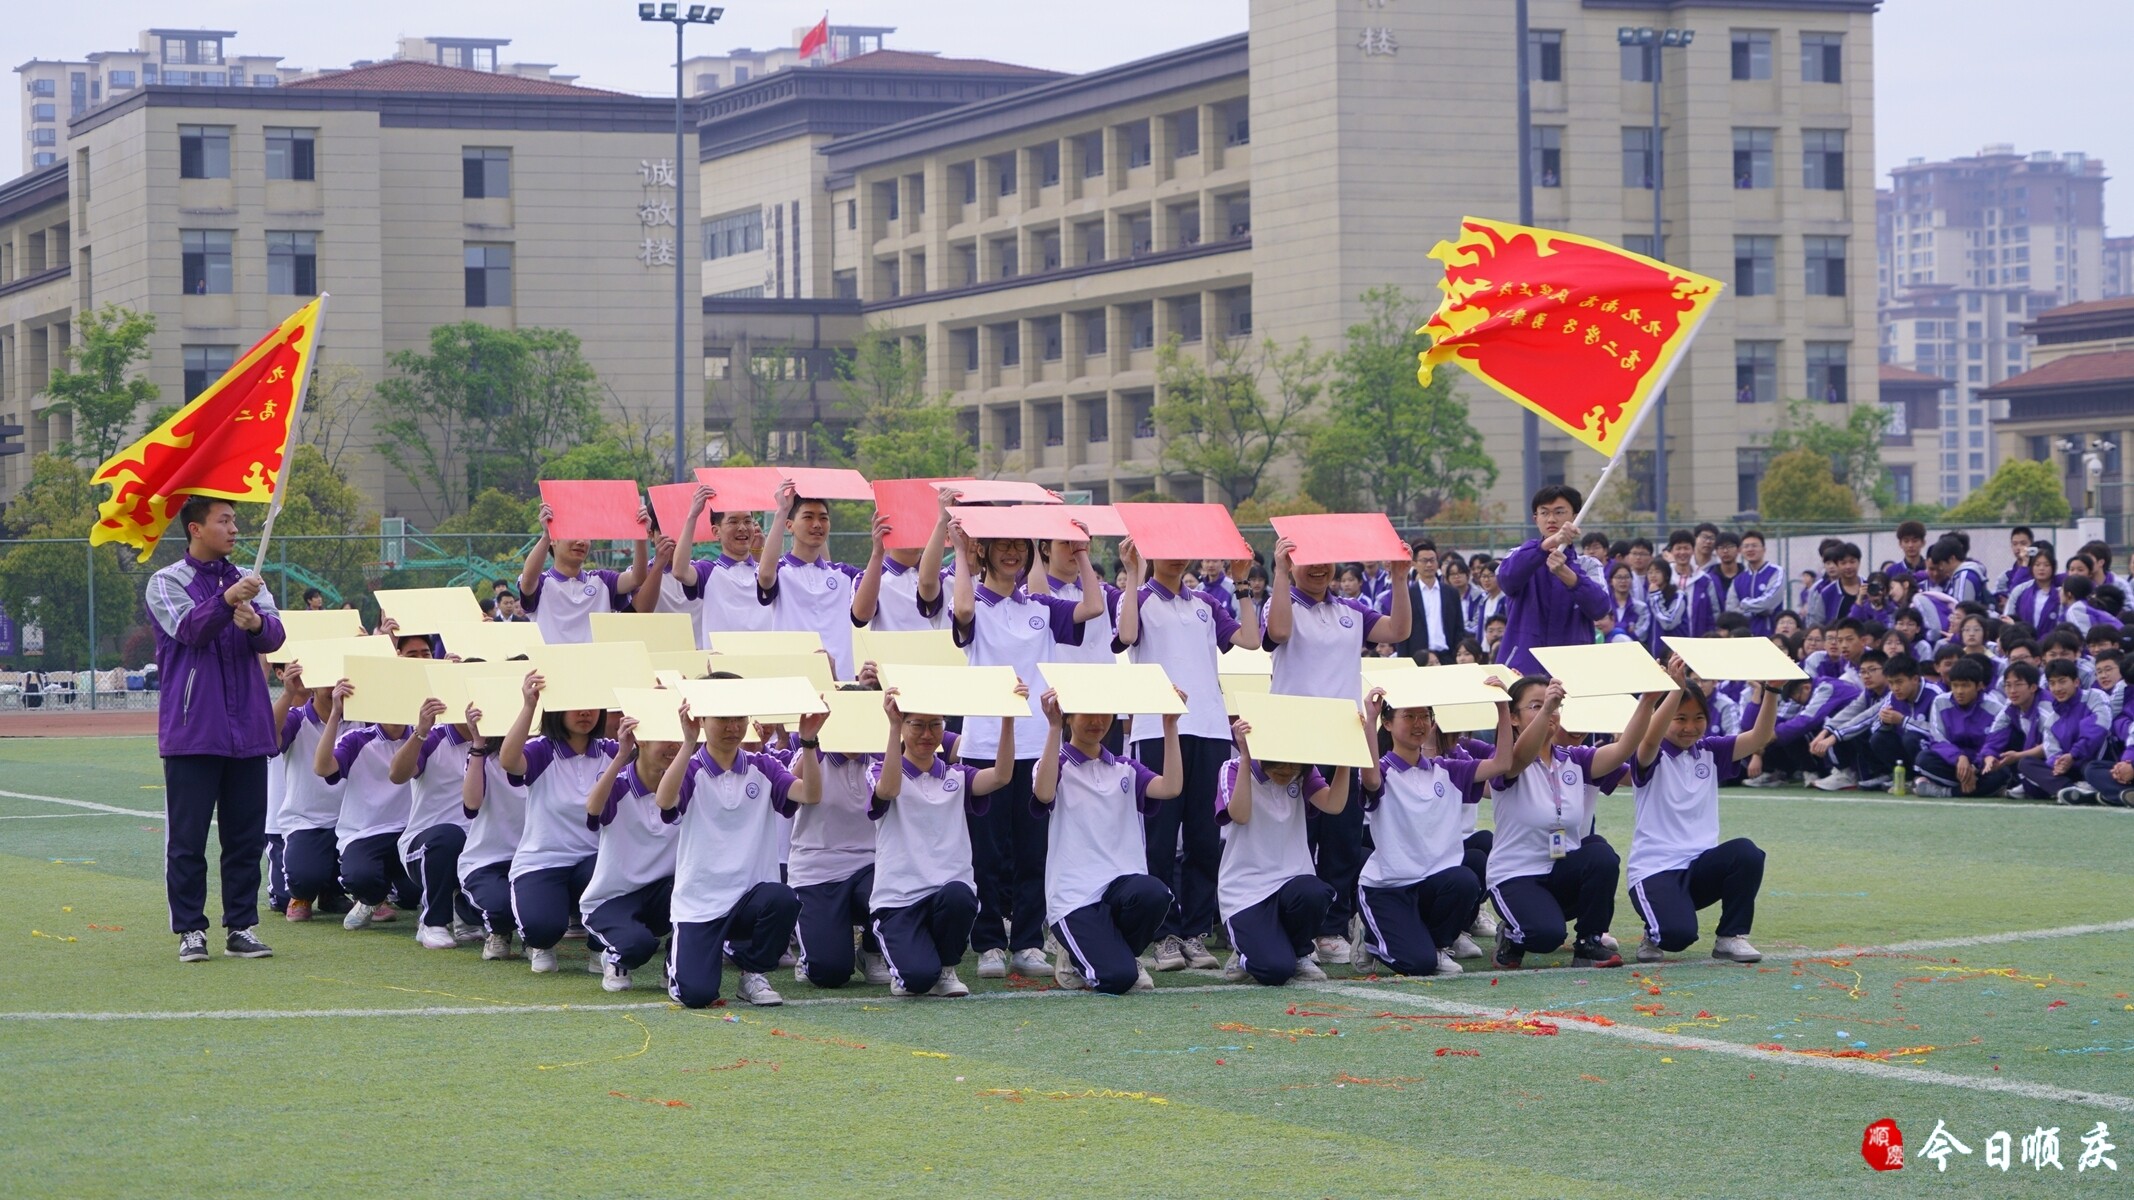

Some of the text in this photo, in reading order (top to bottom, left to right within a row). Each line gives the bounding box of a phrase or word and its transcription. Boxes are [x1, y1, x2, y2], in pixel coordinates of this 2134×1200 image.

[1357, 0, 1398, 57] 楼
[637, 159, 677, 267] 诚敬楼
